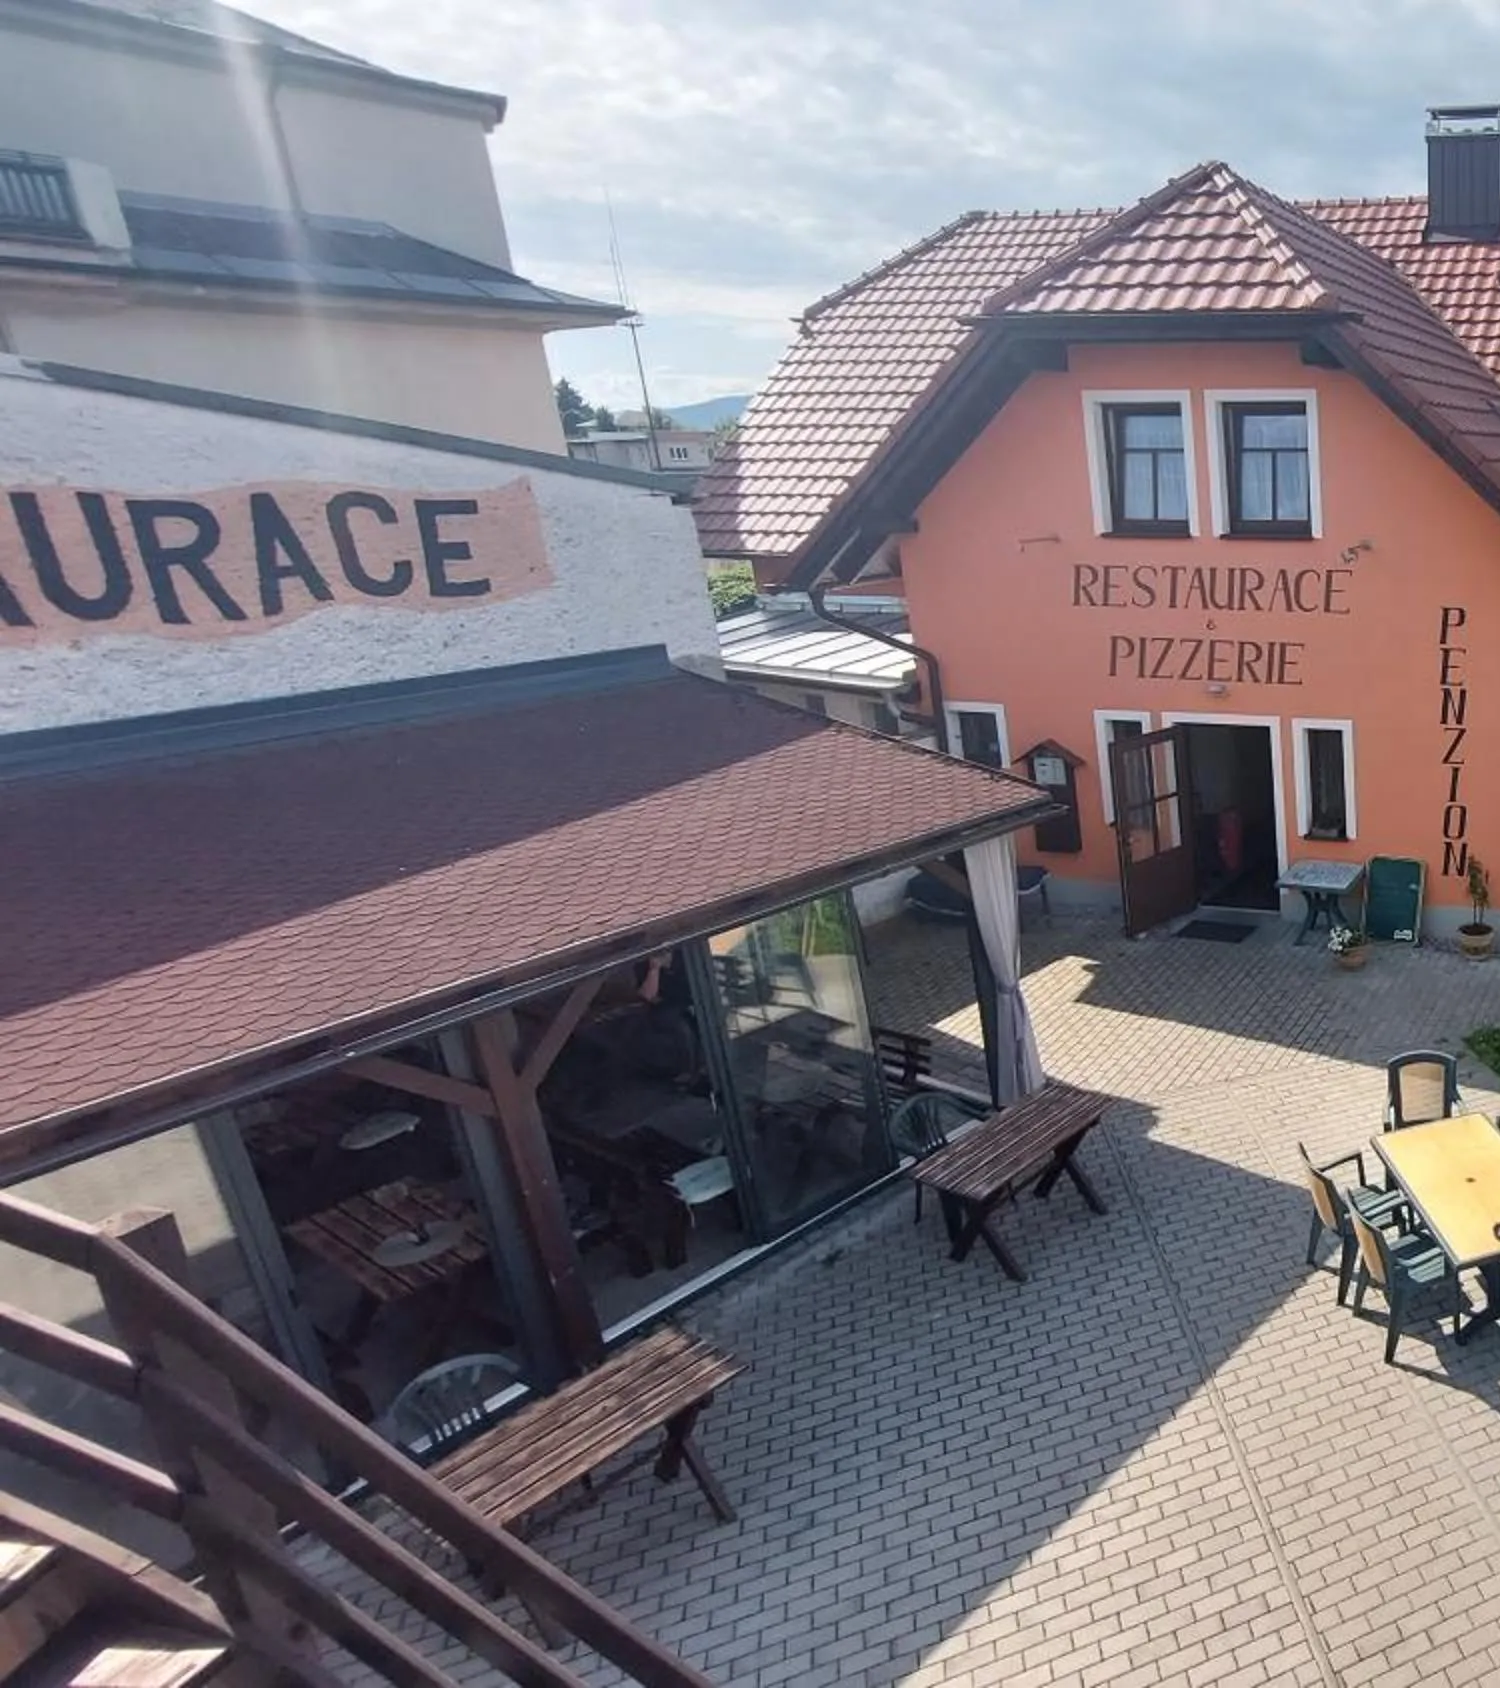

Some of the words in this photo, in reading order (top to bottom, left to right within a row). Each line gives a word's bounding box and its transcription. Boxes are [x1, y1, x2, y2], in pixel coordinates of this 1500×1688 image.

[1072, 564, 1353, 614] RESTAURACE
[1108, 635, 1305, 685] PIZZERIE
[1439, 607, 1467, 877] PENZION
